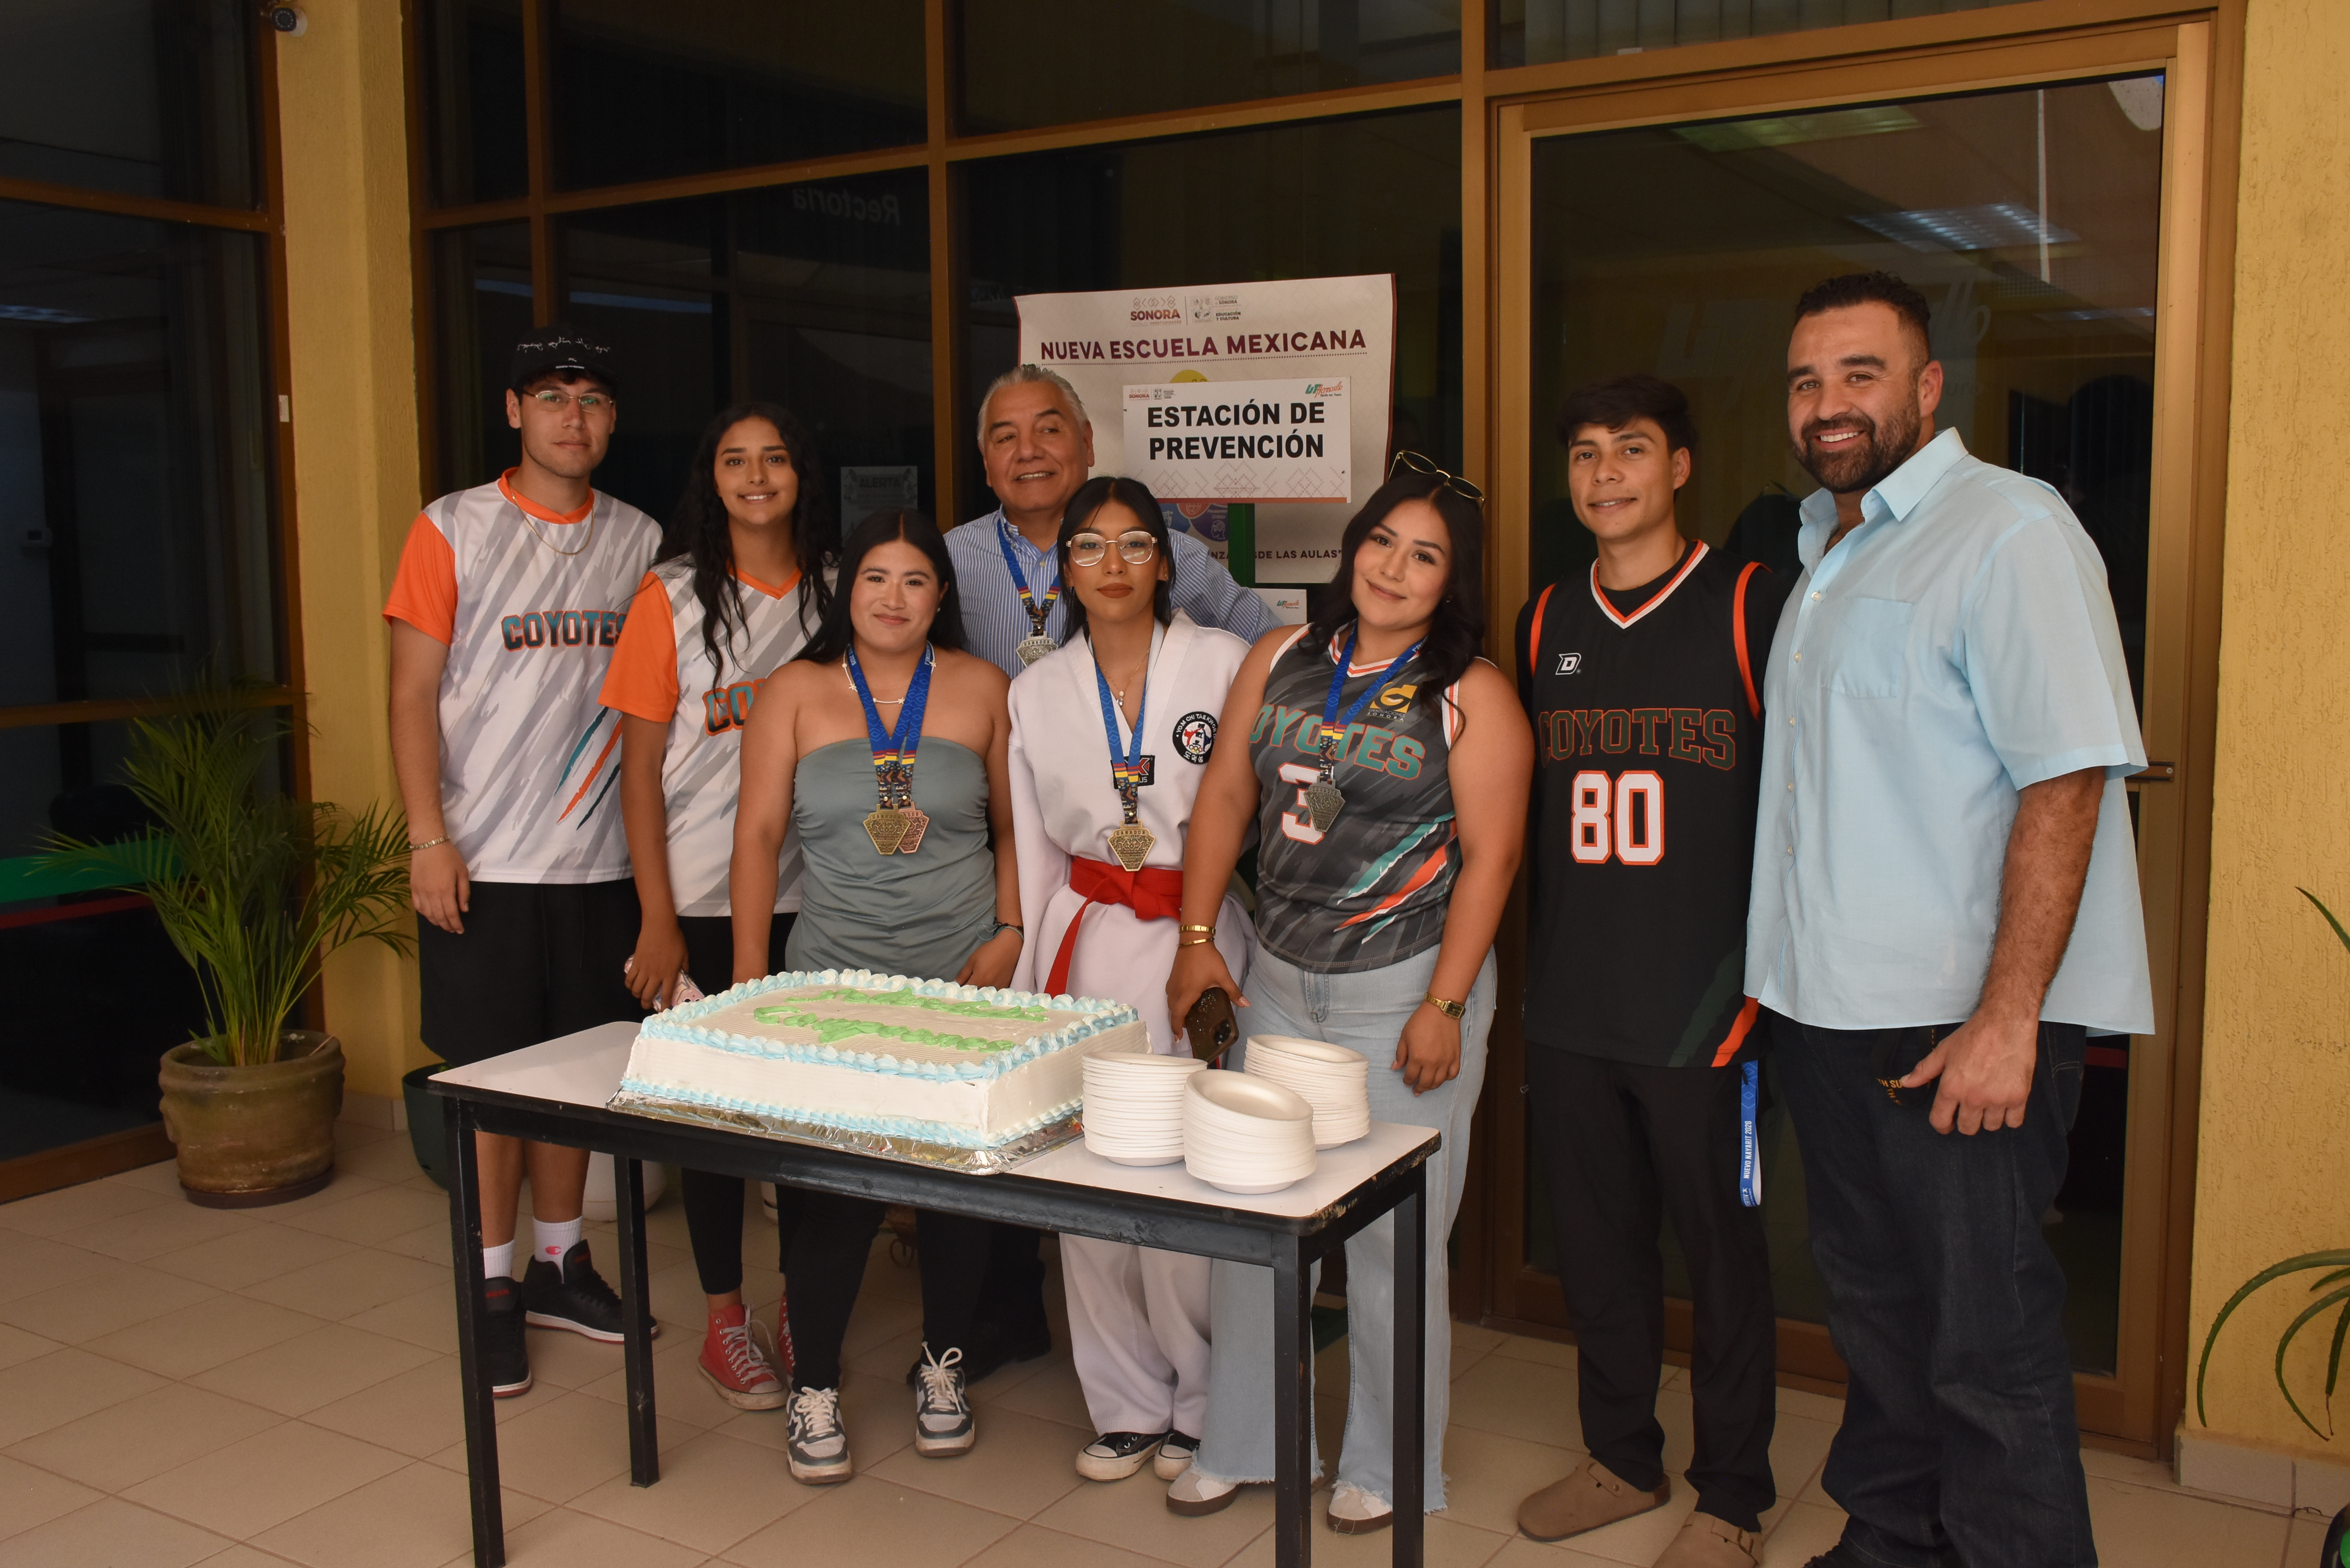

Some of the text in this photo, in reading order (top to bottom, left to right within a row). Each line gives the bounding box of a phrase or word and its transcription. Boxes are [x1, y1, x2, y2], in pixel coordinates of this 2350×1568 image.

[1130, 309, 1181, 321] SONORA
[1041, 329, 1366, 360] NUEVA ESCUELA MEXICANA
[1147, 399, 1325, 428] ESTACIÓN DE
[1149, 429, 1324, 460] PREVENCIÓN
[1276, 550, 1297, 559] LAS
[1176, 720, 1186, 733] YOM
[1367, 712, 1404, 721] SONORA
[1368, 709, 1406, 718] GRADUACIONES
[1539, 708, 1735, 770] COYOTES
[1278, 762, 1326, 845] 3
[1571, 770, 1665, 866] 80
